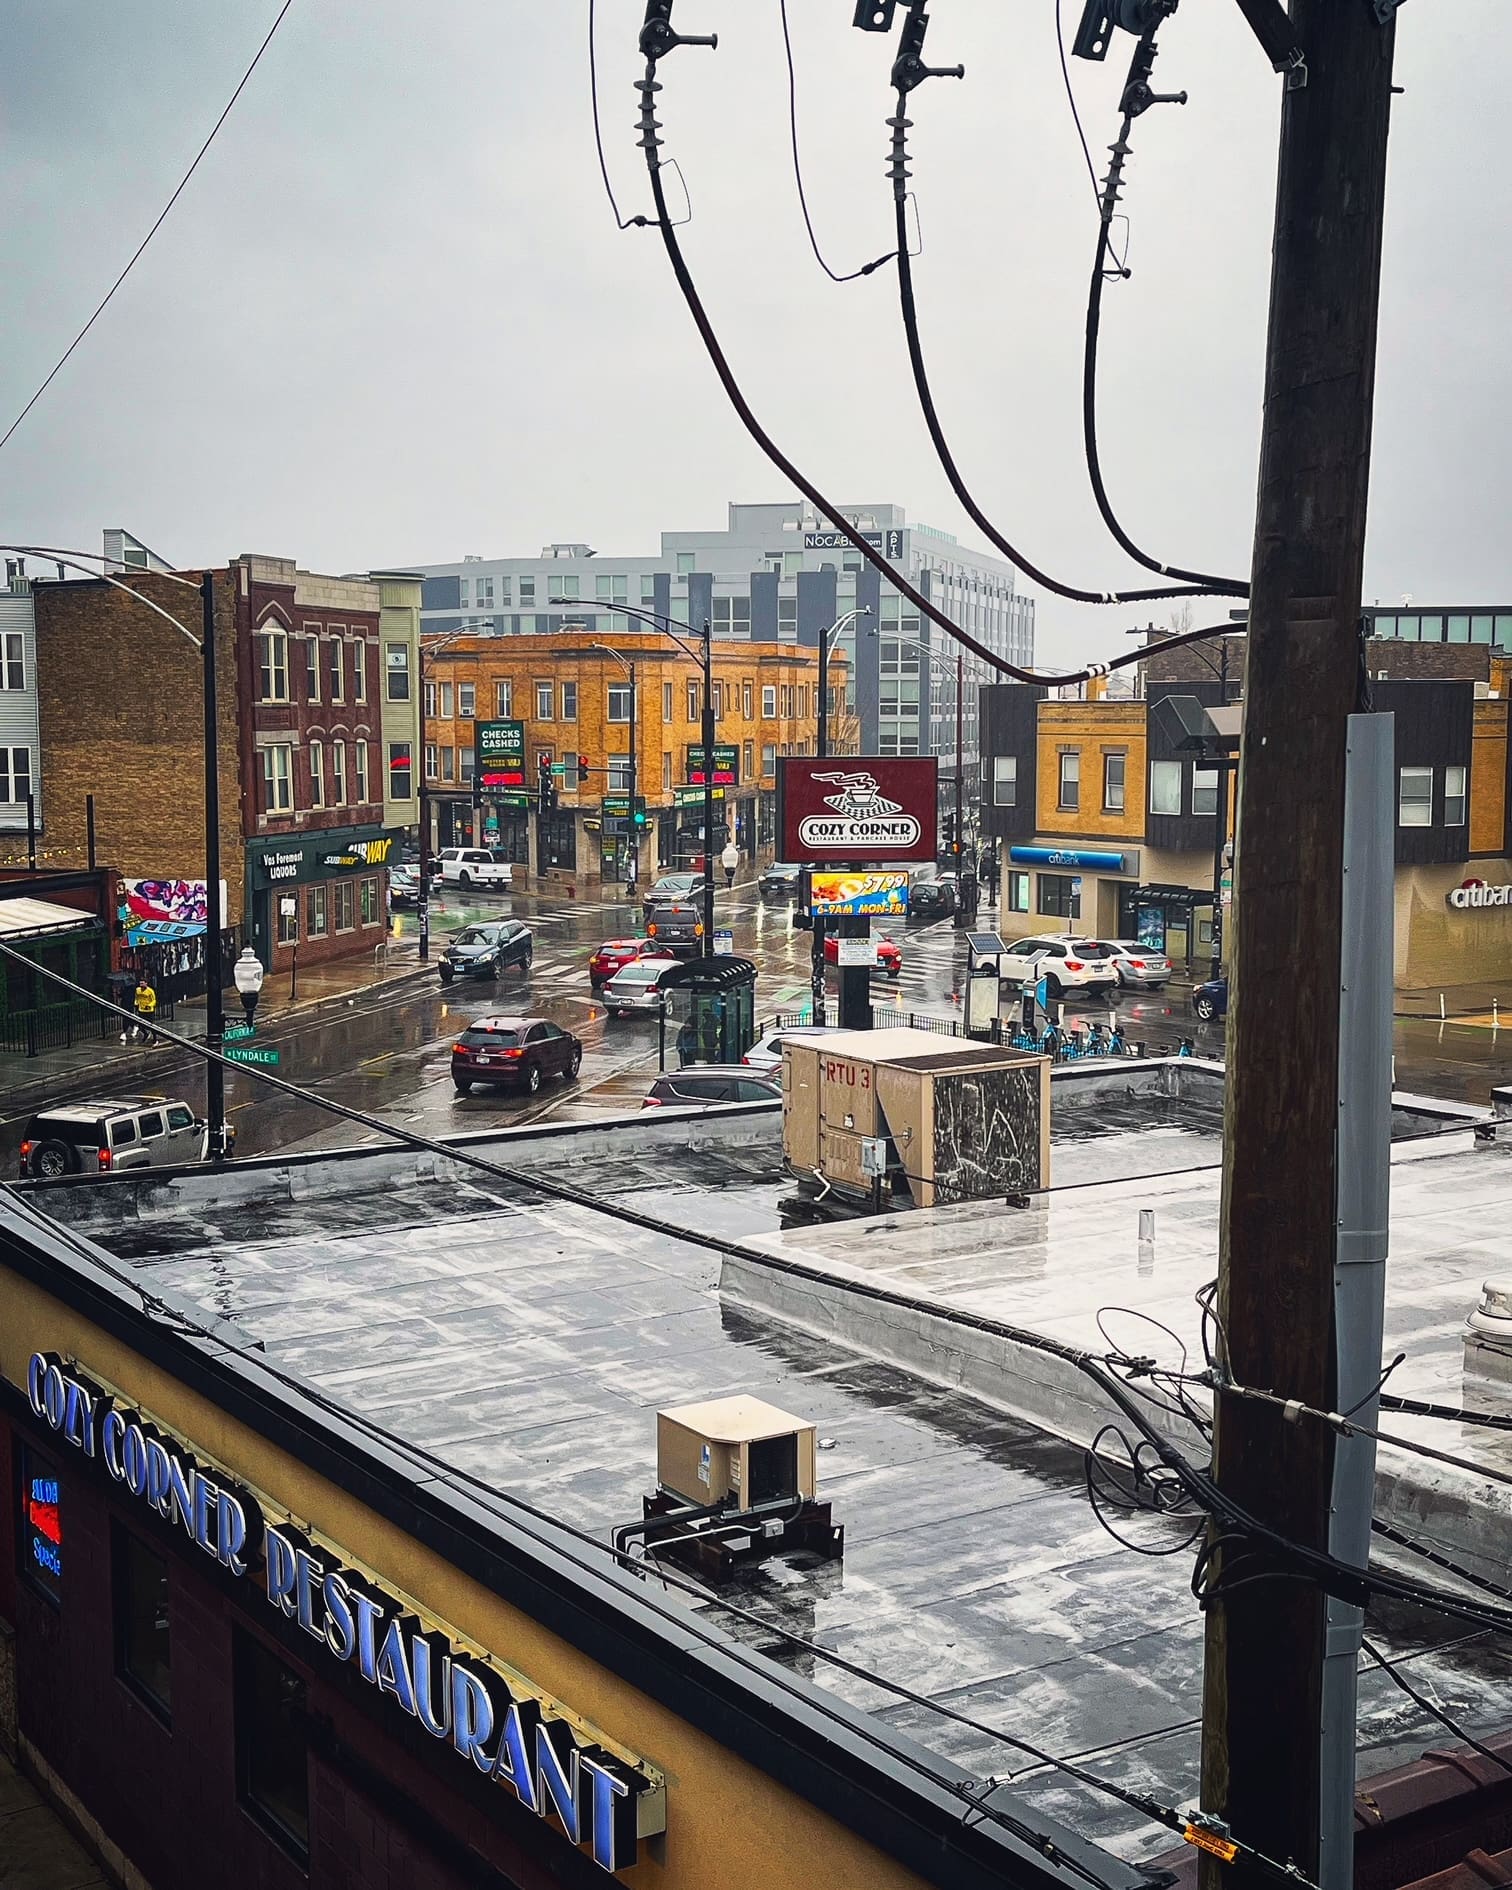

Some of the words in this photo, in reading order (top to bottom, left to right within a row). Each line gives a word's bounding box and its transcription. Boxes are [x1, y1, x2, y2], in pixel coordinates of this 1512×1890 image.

[805, 535, 881, 547] NOCABLcom
[481, 730, 520, 739] CHECKS
[482, 739, 520, 748] CASHED
[808, 823, 846, 835] COZY
[849, 823, 911, 835] CORNER
[276, 850, 303, 864] Foremost
[324, 856, 358, 865] SUBWAY
[1048, 852, 1080, 865] citibank
[270, 864, 296, 879] LIQUORS
[817, 903, 853, 914] 6-9AM
[858, 903, 906, 915] MON-FRI
[232, 1050, 270, 1062] LYNDALE
[826, 1061, 855, 1086] RTU
[860, 1068, 870, 1089] 3
[27, 1352, 99, 1458] COZY
[103, 1410, 247, 1576] CORNER
[265, 1524, 629, 1873] RESTAURANT
